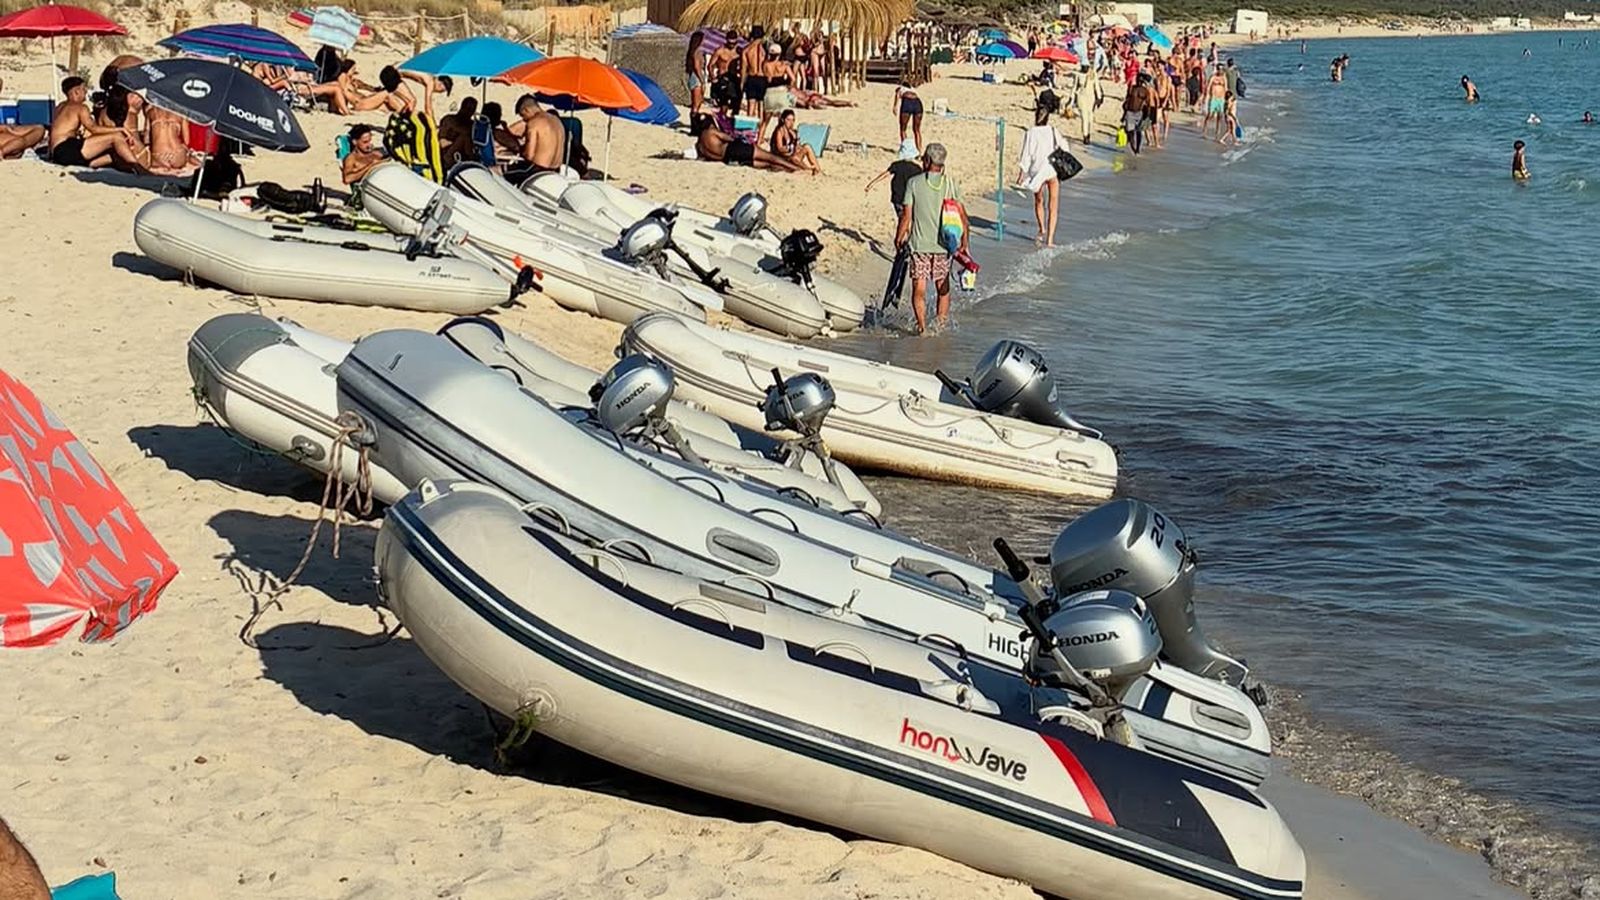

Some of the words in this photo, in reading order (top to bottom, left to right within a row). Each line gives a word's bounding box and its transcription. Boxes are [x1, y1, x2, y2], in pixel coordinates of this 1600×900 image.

[1012, 345, 1025, 363] 15
[615, 382, 651, 410] HONDA
[1150, 511, 1166, 549] 20
[1067, 567, 1129, 594] HONDA
[1058, 630, 1120, 648] HONDA
